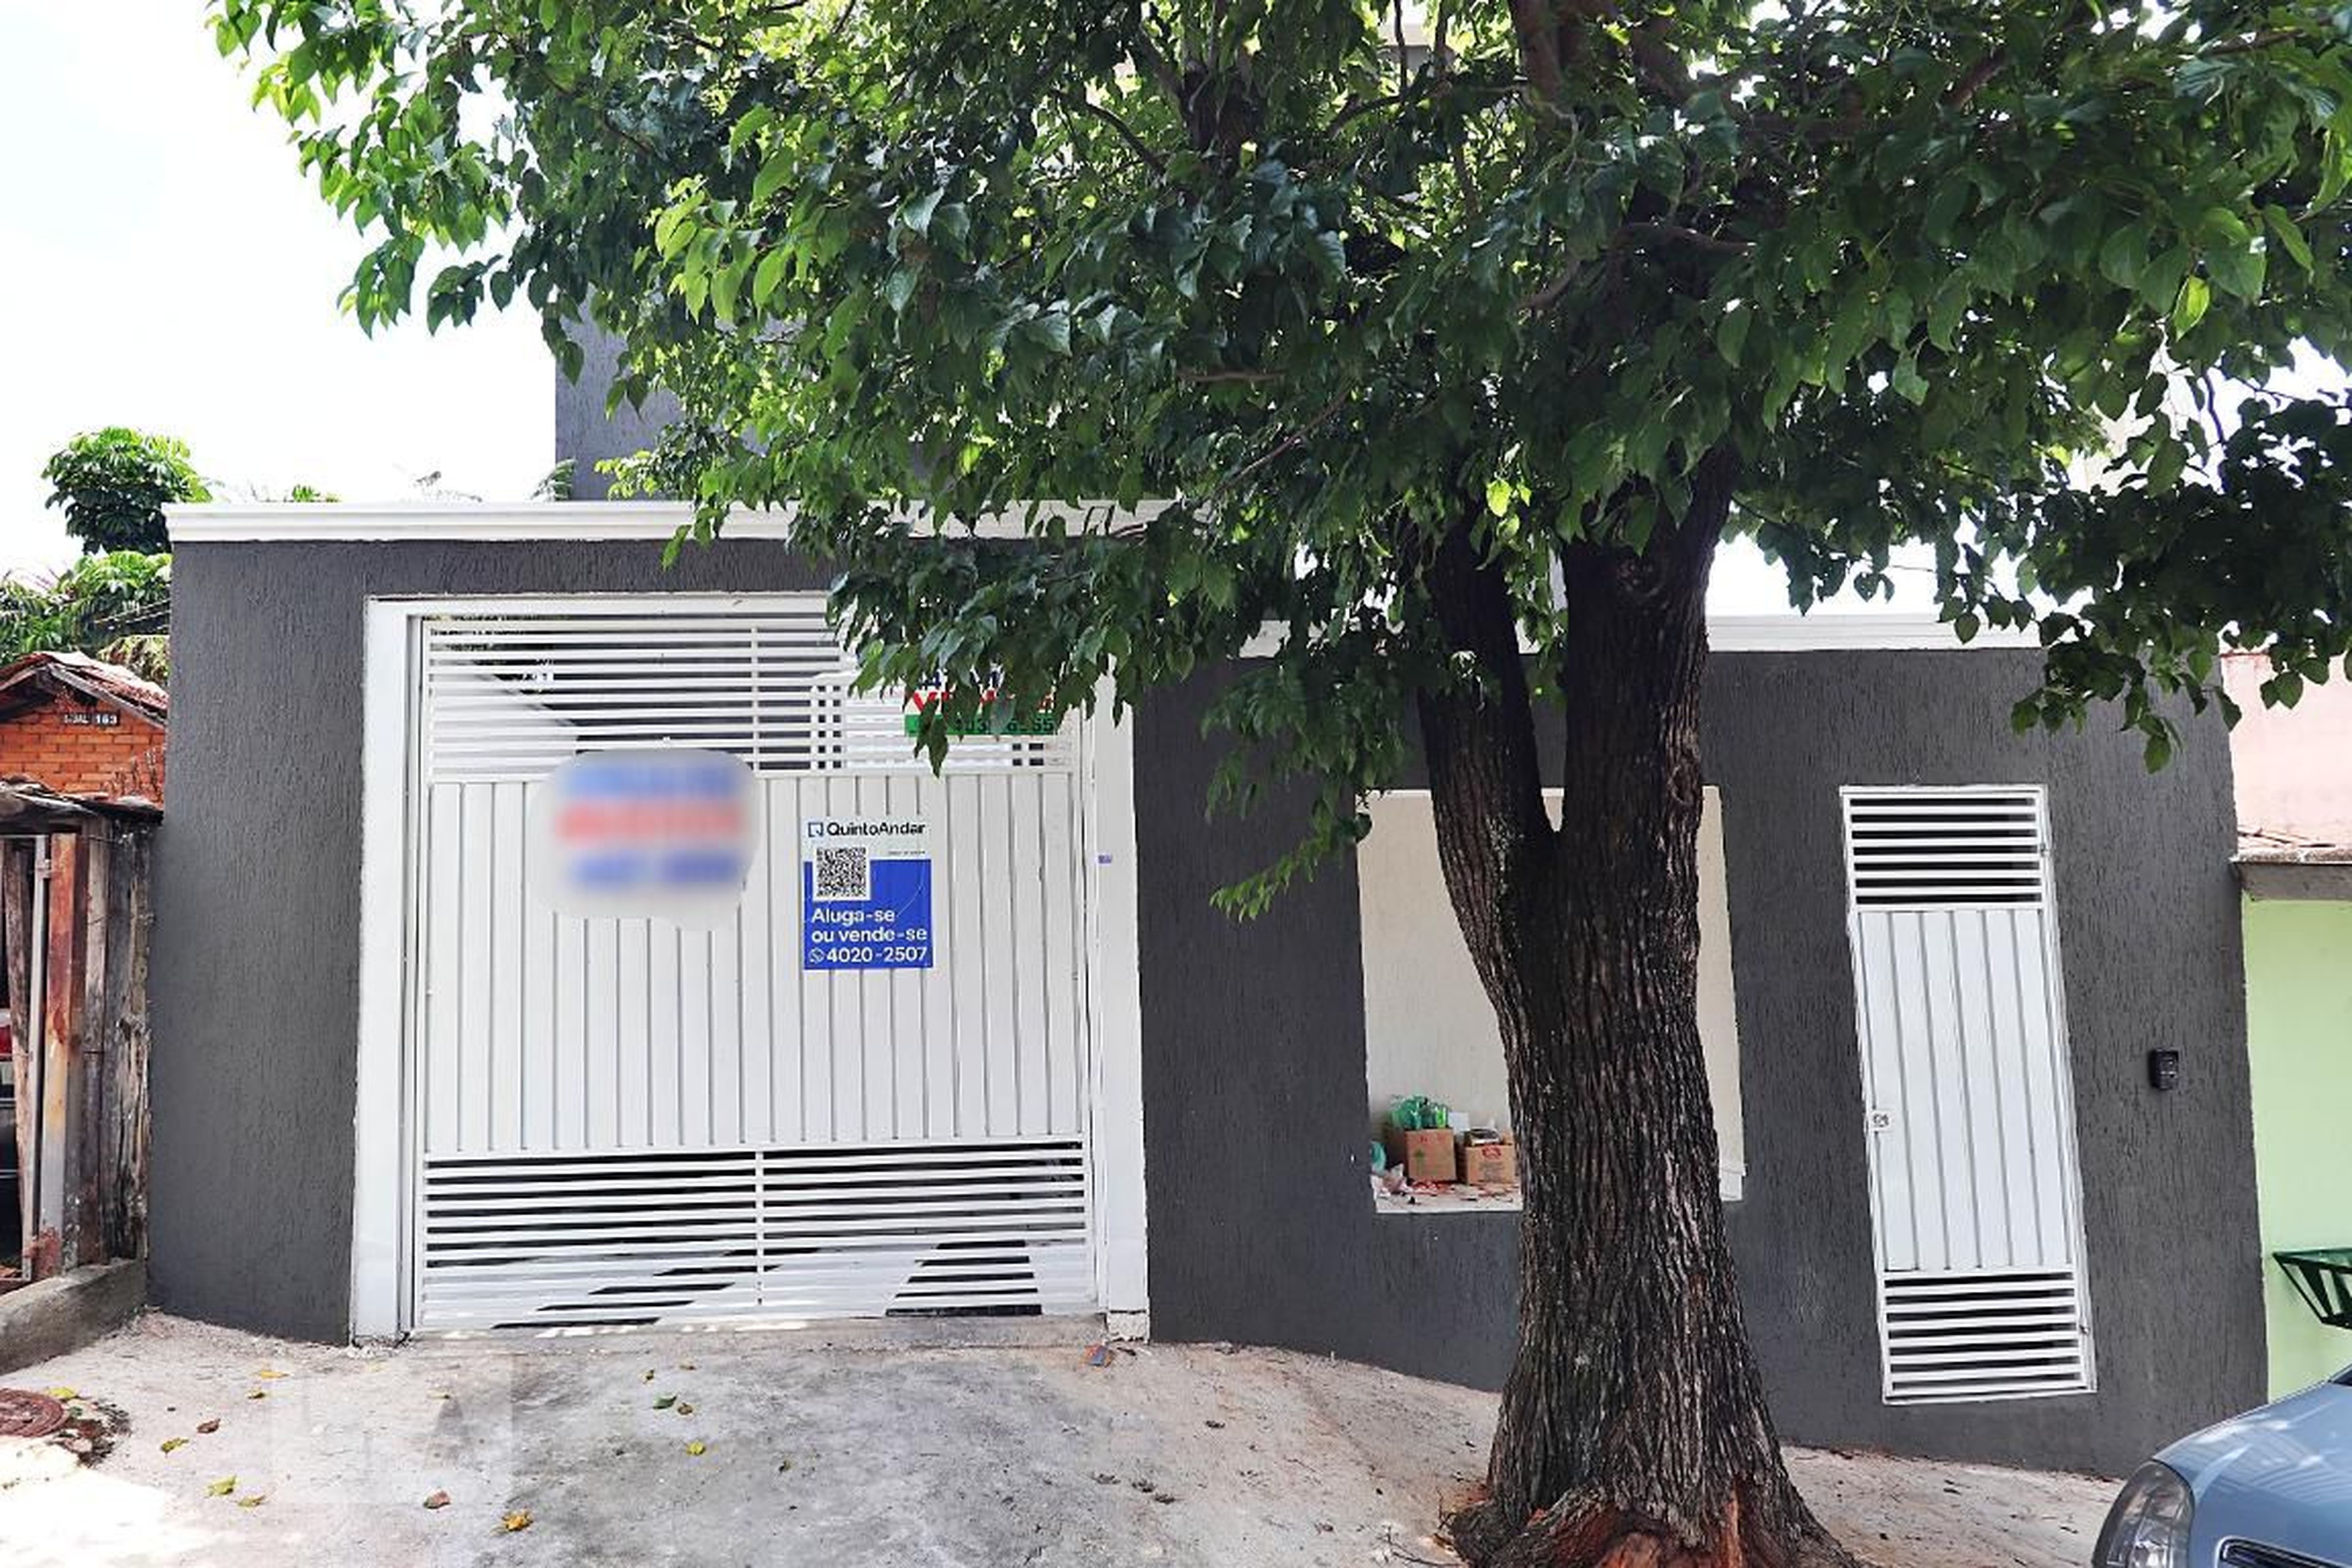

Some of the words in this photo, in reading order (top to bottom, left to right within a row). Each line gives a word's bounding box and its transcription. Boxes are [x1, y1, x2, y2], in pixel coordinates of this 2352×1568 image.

[827, 822, 925, 835] QuintoAndar
[812, 908, 895, 926] Aluga-se
[812, 930, 834, 943] ou
[839, 927, 927, 943] vende-se
[827, 947, 927, 962] 4020-2507
